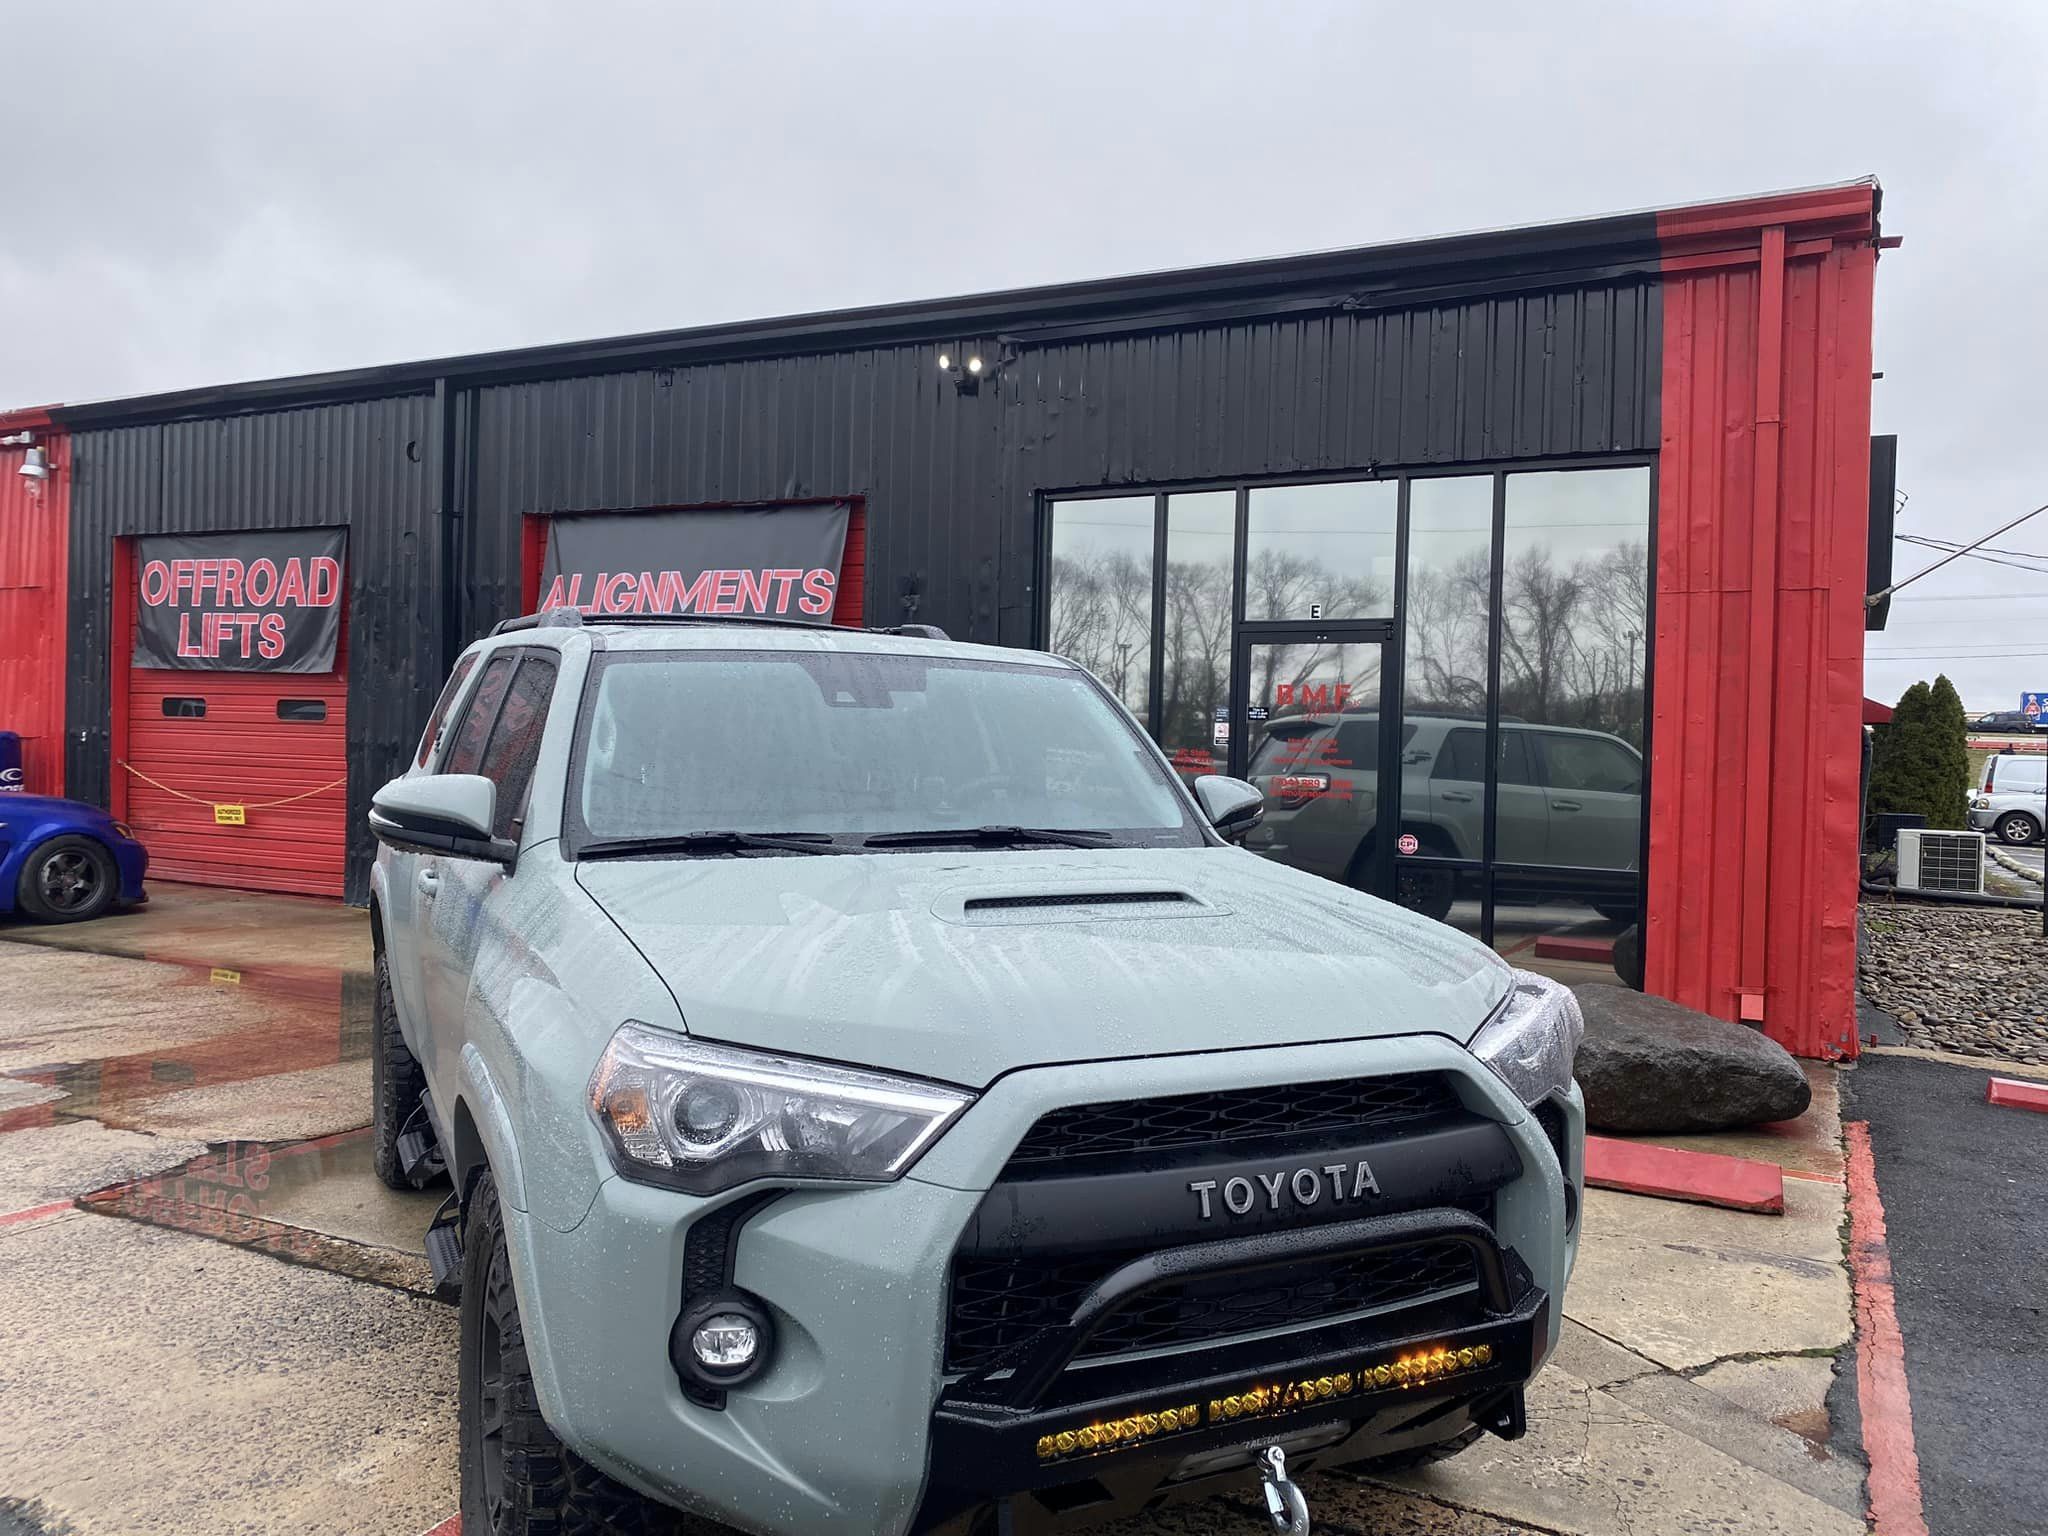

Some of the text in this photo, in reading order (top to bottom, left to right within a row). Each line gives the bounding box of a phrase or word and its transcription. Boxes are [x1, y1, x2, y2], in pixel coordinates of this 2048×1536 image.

[141, 556, 340, 607] OFFROAD
[540, 568, 836, 615] ALIGNMENTS
[1311, 604, 1321, 619] E
[177, 612, 286, 660] LIFTS
[1188, 1161, 1381, 1218] TOYOTA
